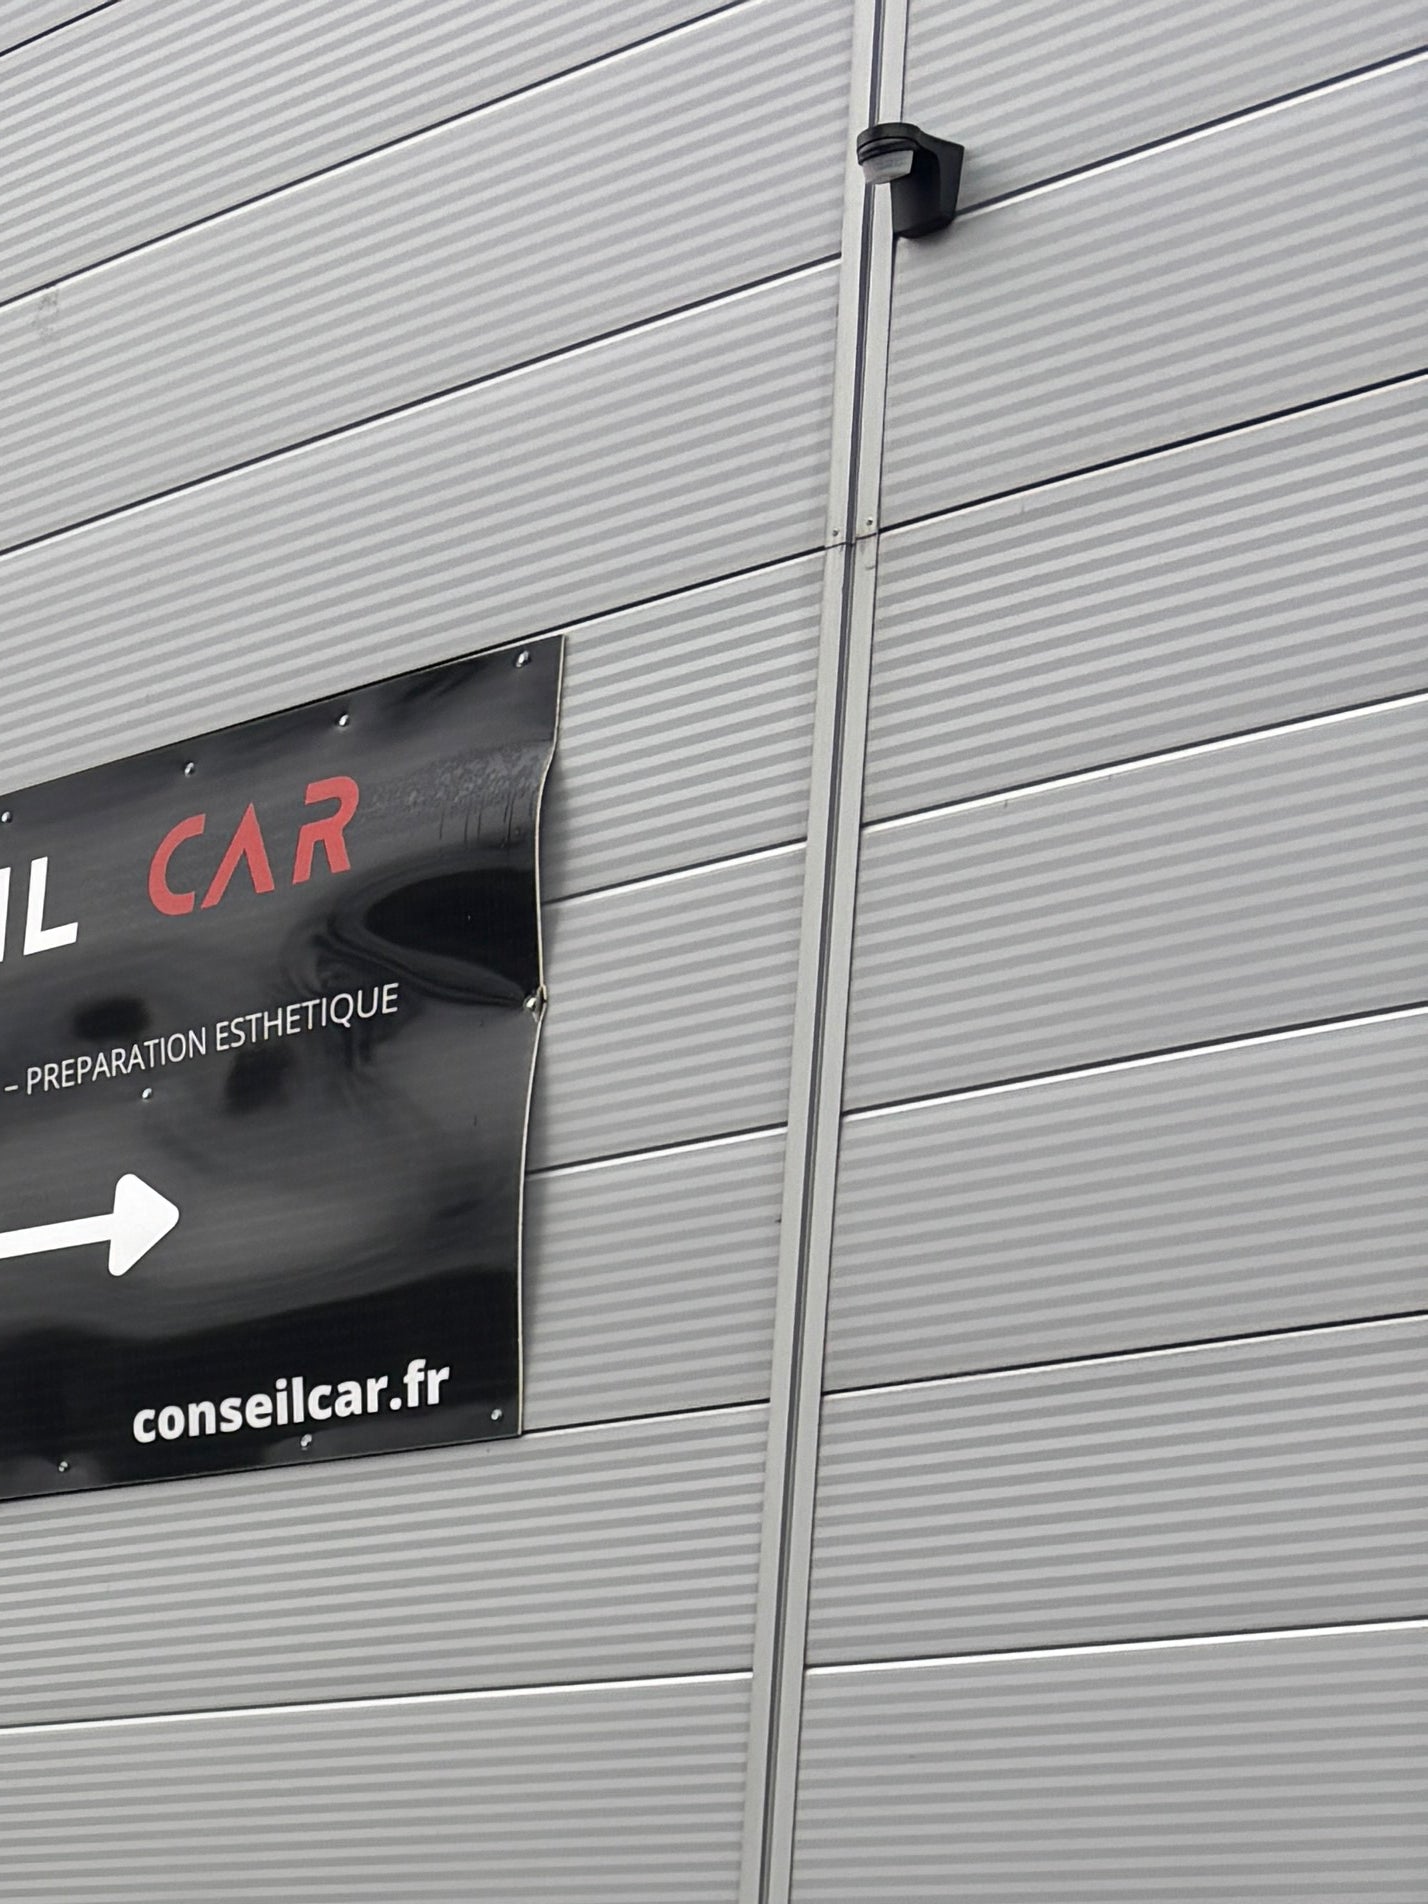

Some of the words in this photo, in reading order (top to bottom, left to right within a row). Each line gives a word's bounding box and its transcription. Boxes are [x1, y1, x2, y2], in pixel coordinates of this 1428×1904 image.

[148, 776, 359, 916] CAR
[27, 1026, 207, 1095] PREPARATION
[216, 982, 400, 1051] ESTHETIQUE
[133, 1359, 450, 1443] conseilcar.fr
